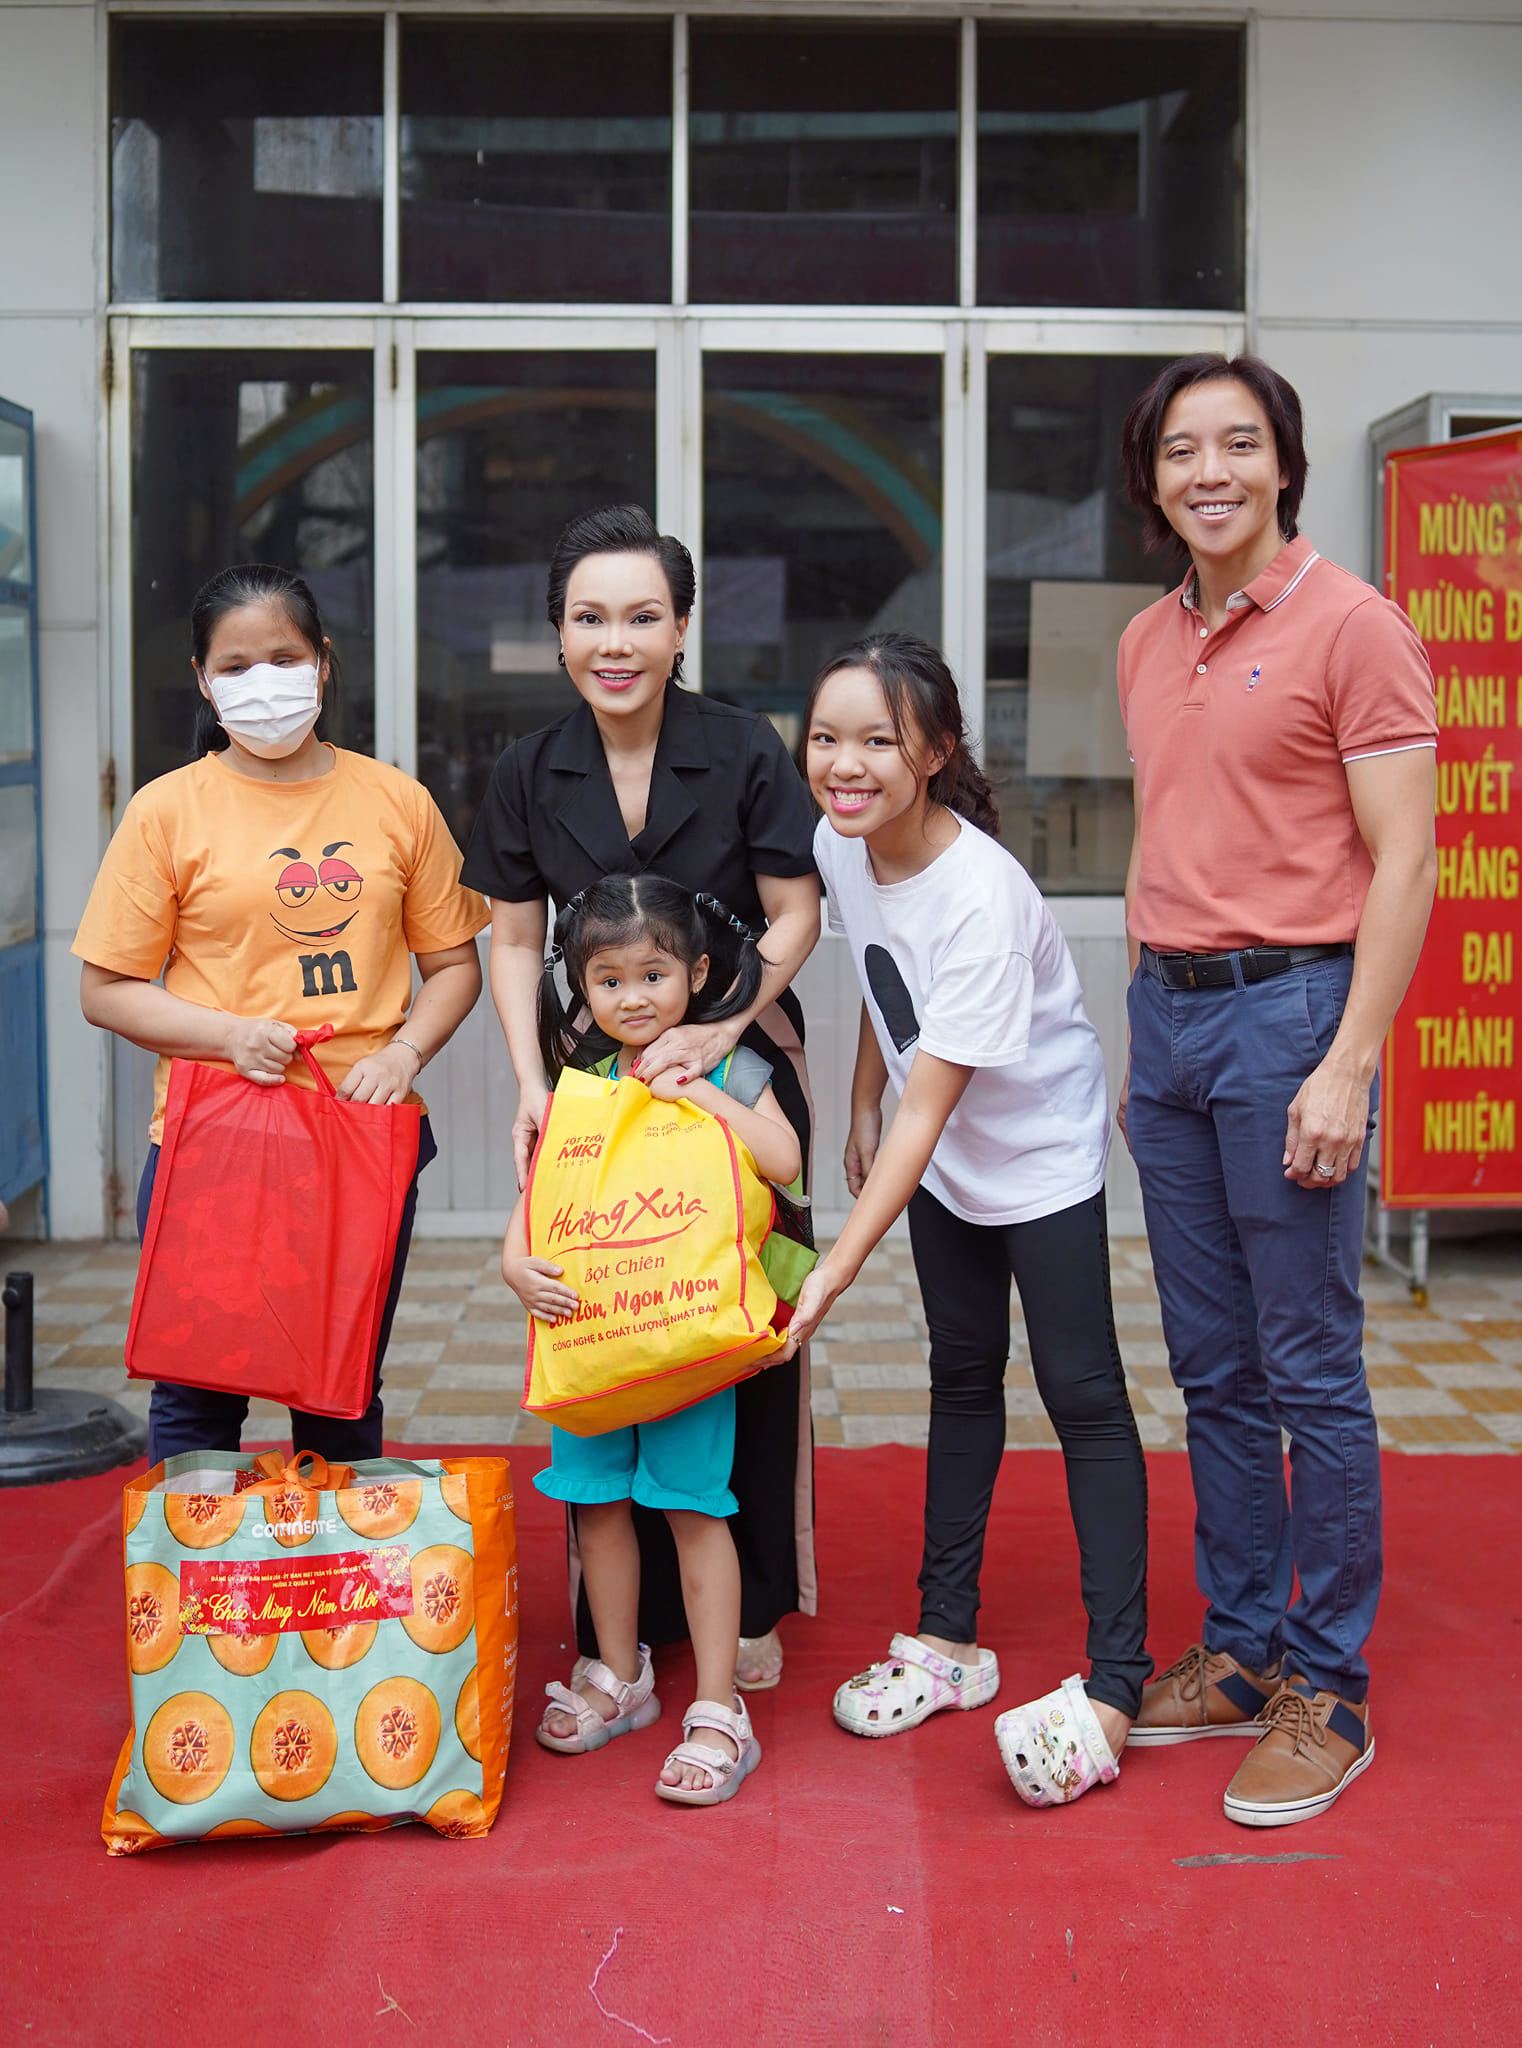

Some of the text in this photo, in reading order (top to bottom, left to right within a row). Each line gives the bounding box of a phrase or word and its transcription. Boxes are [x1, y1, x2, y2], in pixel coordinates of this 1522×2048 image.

[1419, 492, 1507, 556] MỪNG
[1408, 578, 1495, 642] MỪNG
[1436, 664, 1506, 728] HÀNH
[1435, 742, 1514, 815] UYẾT
[1436, 830, 1519, 899] HẮNG
[1462, 931, 1513, 994] ĐẠI
[1424, 1090, 1516, 1163] NHIỆM
[585, 1255, 665, 1284] Bột Chiên
[613, 1289, 664, 1316] Ngon
[669, 1278, 719, 1302] Ngon
[597, 1332, 604, 1342] &
[209, 1583, 379, 1628] Chúc Mừng Năm Mới
